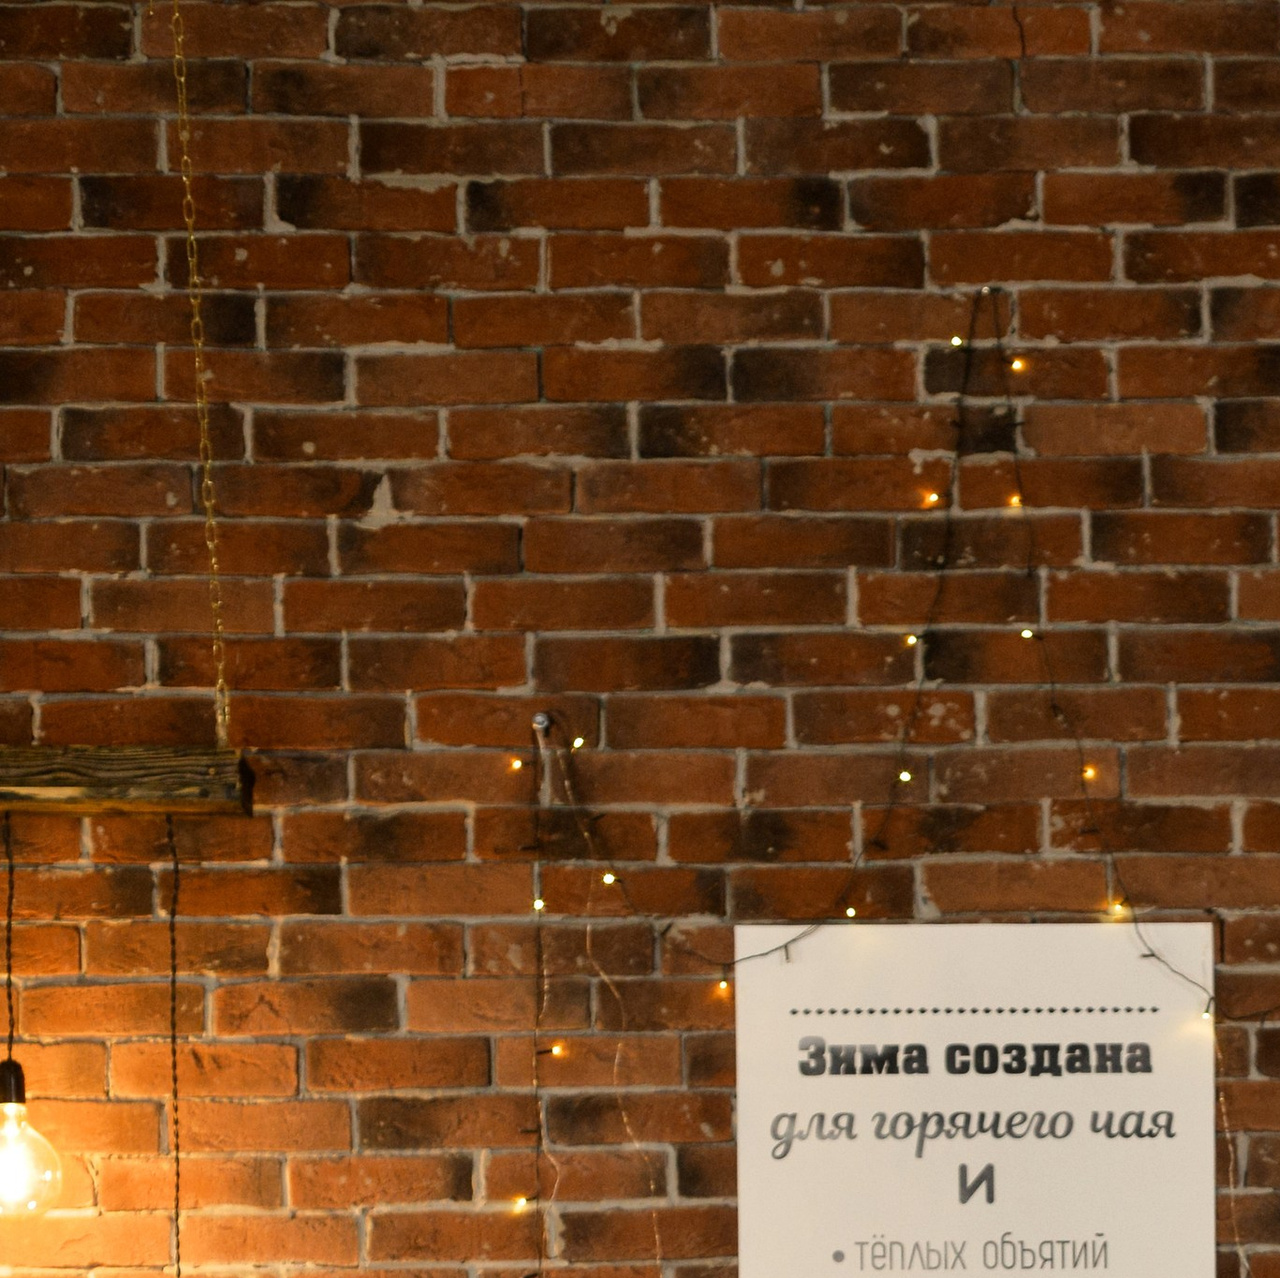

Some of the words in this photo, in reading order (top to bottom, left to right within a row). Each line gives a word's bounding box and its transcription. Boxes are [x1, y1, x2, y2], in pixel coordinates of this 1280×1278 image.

[798, 1037, 930, 1077] Зима
[943, 1041, 1154, 1079] создана
[770, 1111, 859, 1161] для
[871, 1110, 1076, 1158] горячего
[1089, 1110, 1177, 1140] чая
[854, 1234, 967, 1271] тёплых
[982, 1231, 1109, 1271] объятий
